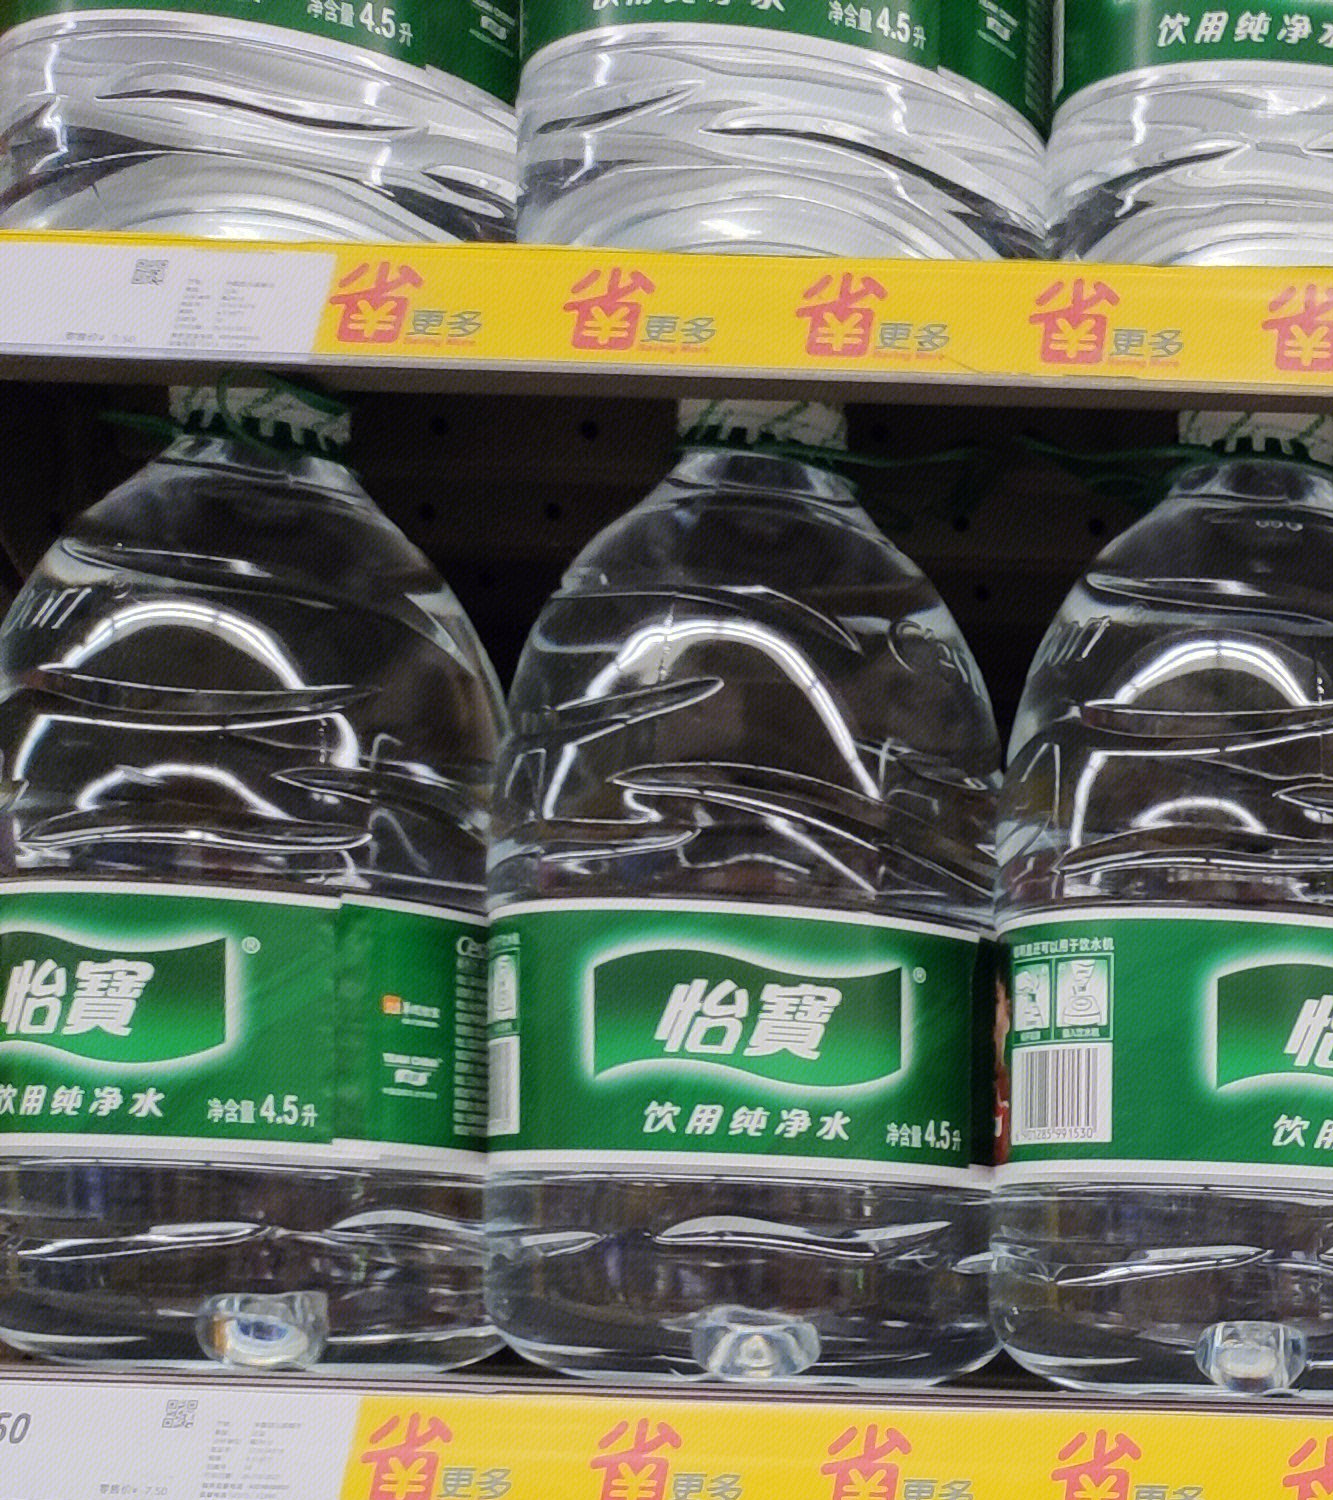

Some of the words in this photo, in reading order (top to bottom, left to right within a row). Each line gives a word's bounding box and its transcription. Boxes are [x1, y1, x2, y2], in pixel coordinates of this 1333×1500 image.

[331, 264, 421, 343] 省
[408, 309, 483, 338] 更多
[798, 274, 885, 357] 省
[876, 322, 949, 352] 更多
[206, 1093, 319, 1128] 净含量4.5升
[642, 1100, 851, 1142] 饮用纯净水
[439, 1467, 512, 1500] 更多
